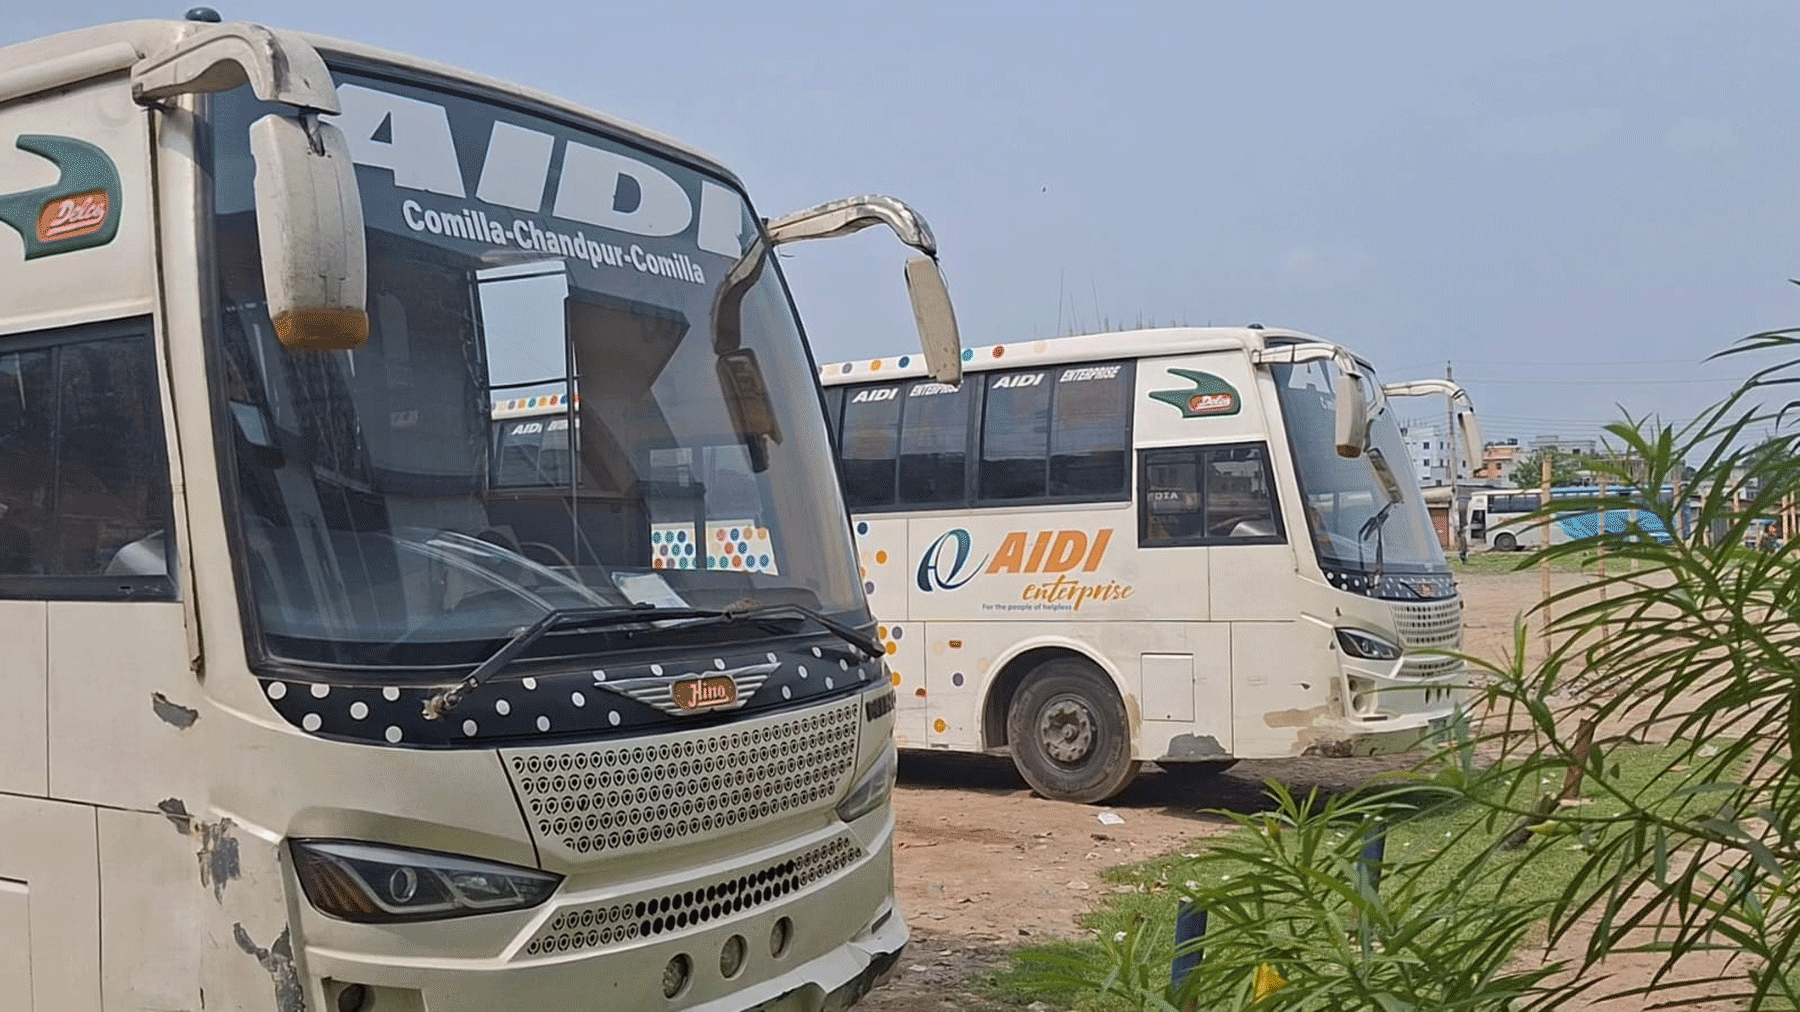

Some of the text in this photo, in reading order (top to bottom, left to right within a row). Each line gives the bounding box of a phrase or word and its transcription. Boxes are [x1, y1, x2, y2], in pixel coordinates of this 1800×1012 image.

[317, 83, 743, 259] AIDI
[402, 198, 706, 286] Comilla-Chandpur-Comilla
[991, 365, 1121, 389] AIDI ENTERPRISE
[851, 387, 899, 404] AIDI
[985, 528, 1114, 574] AIDI
[1008, 603, 1032, 611] people
[1042, 603, 1071, 611] helpless
[1022, 574, 1134, 611] enterprise
[687, 679, 727, 707] Hino
